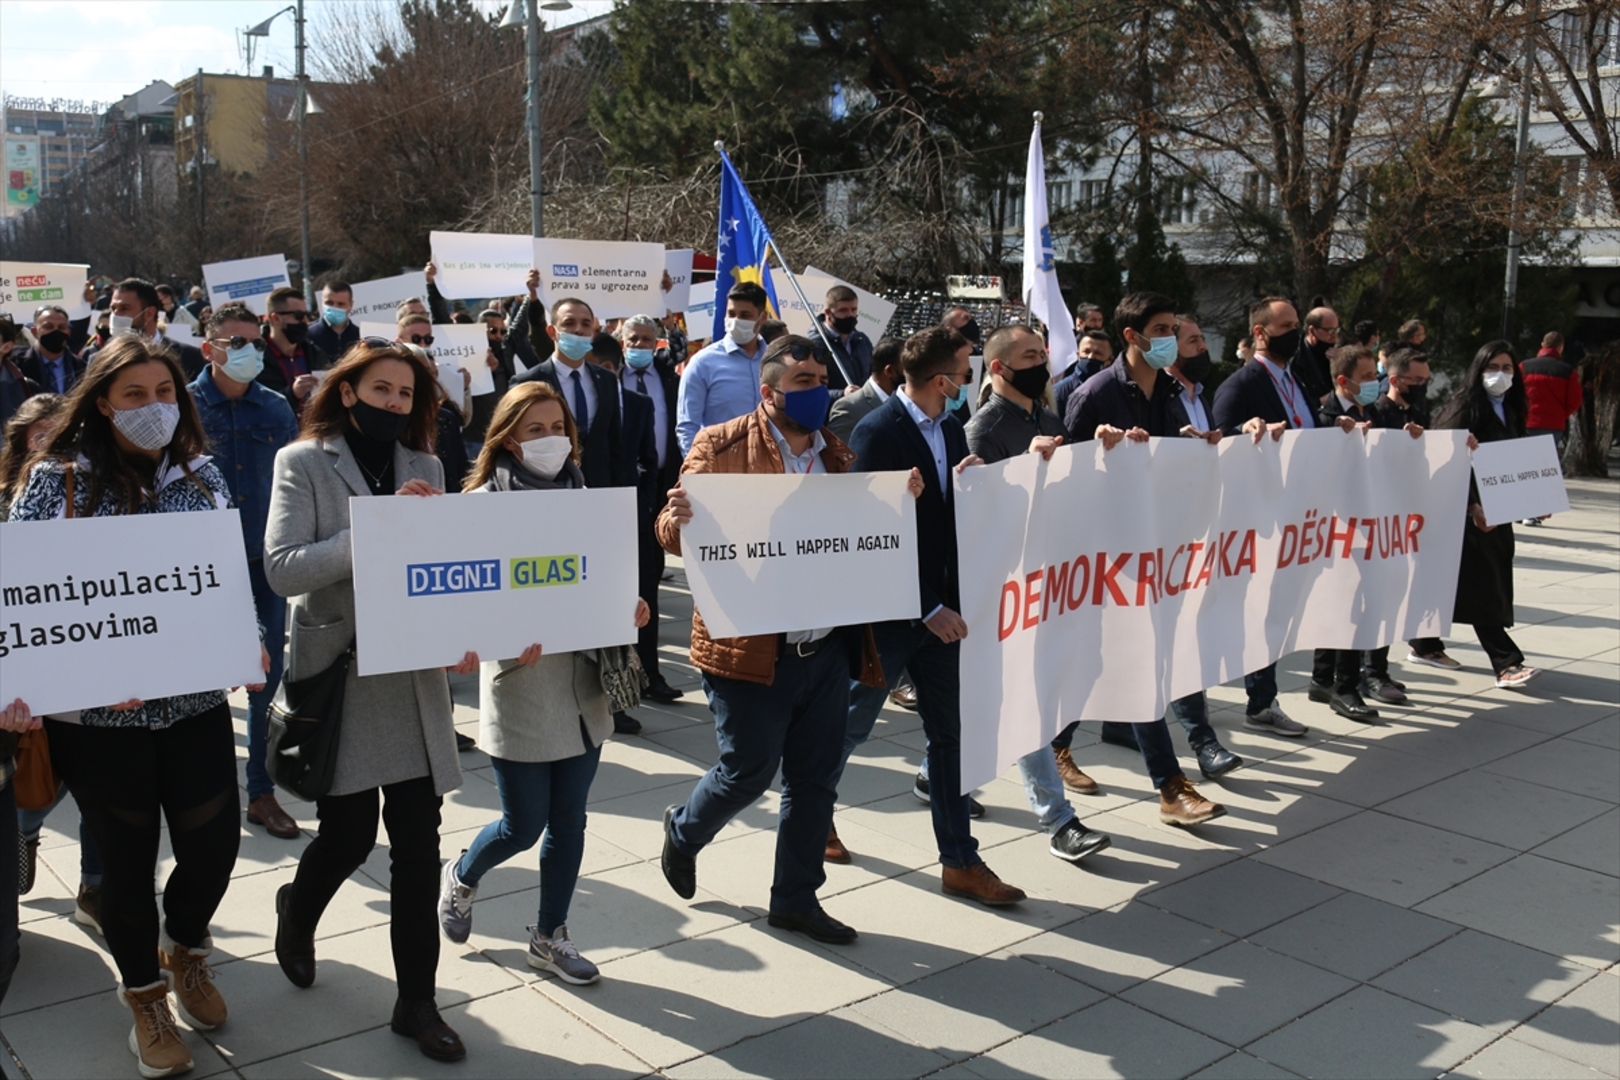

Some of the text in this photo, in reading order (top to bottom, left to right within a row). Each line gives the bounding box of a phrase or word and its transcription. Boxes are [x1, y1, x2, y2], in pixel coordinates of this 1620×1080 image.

[459, 262, 476, 270] glas
[494, 262, 532, 271] vrijednost
[553, 264, 647, 278] NASA elementarna
[19, 291, 33, 301] ne
[40, 289, 62, 300] dam
[551, 281, 580, 291] prava
[601, 283, 649, 293] ugrozena
[430, 345, 476, 358] ulaciji
[1481, 467, 1559, 487] THIS WILL HAPPEN AGAIN
[1276, 508, 1425, 570] DËSHTUAR
[699, 534, 900, 562] THIS WILL HAPPEN AGAIN
[411, 555, 588, 594] DIGNI GLAS!
[3, 563, 221, 606] manipulaciji
